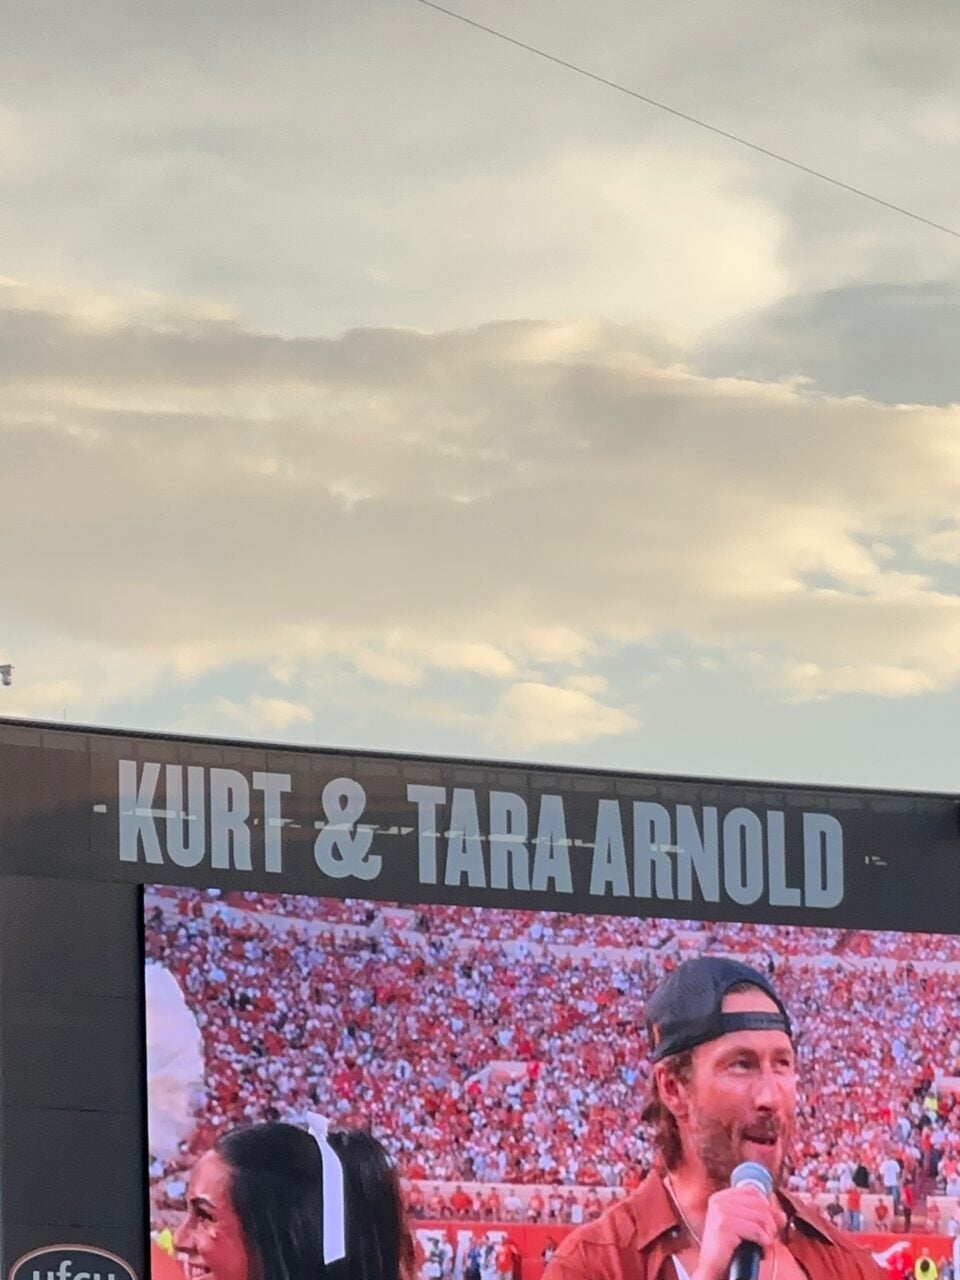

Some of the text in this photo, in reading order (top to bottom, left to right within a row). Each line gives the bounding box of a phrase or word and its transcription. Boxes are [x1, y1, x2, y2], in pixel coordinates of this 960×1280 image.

[118, 760, 844, 908] KURT & TARA ARNOLD
